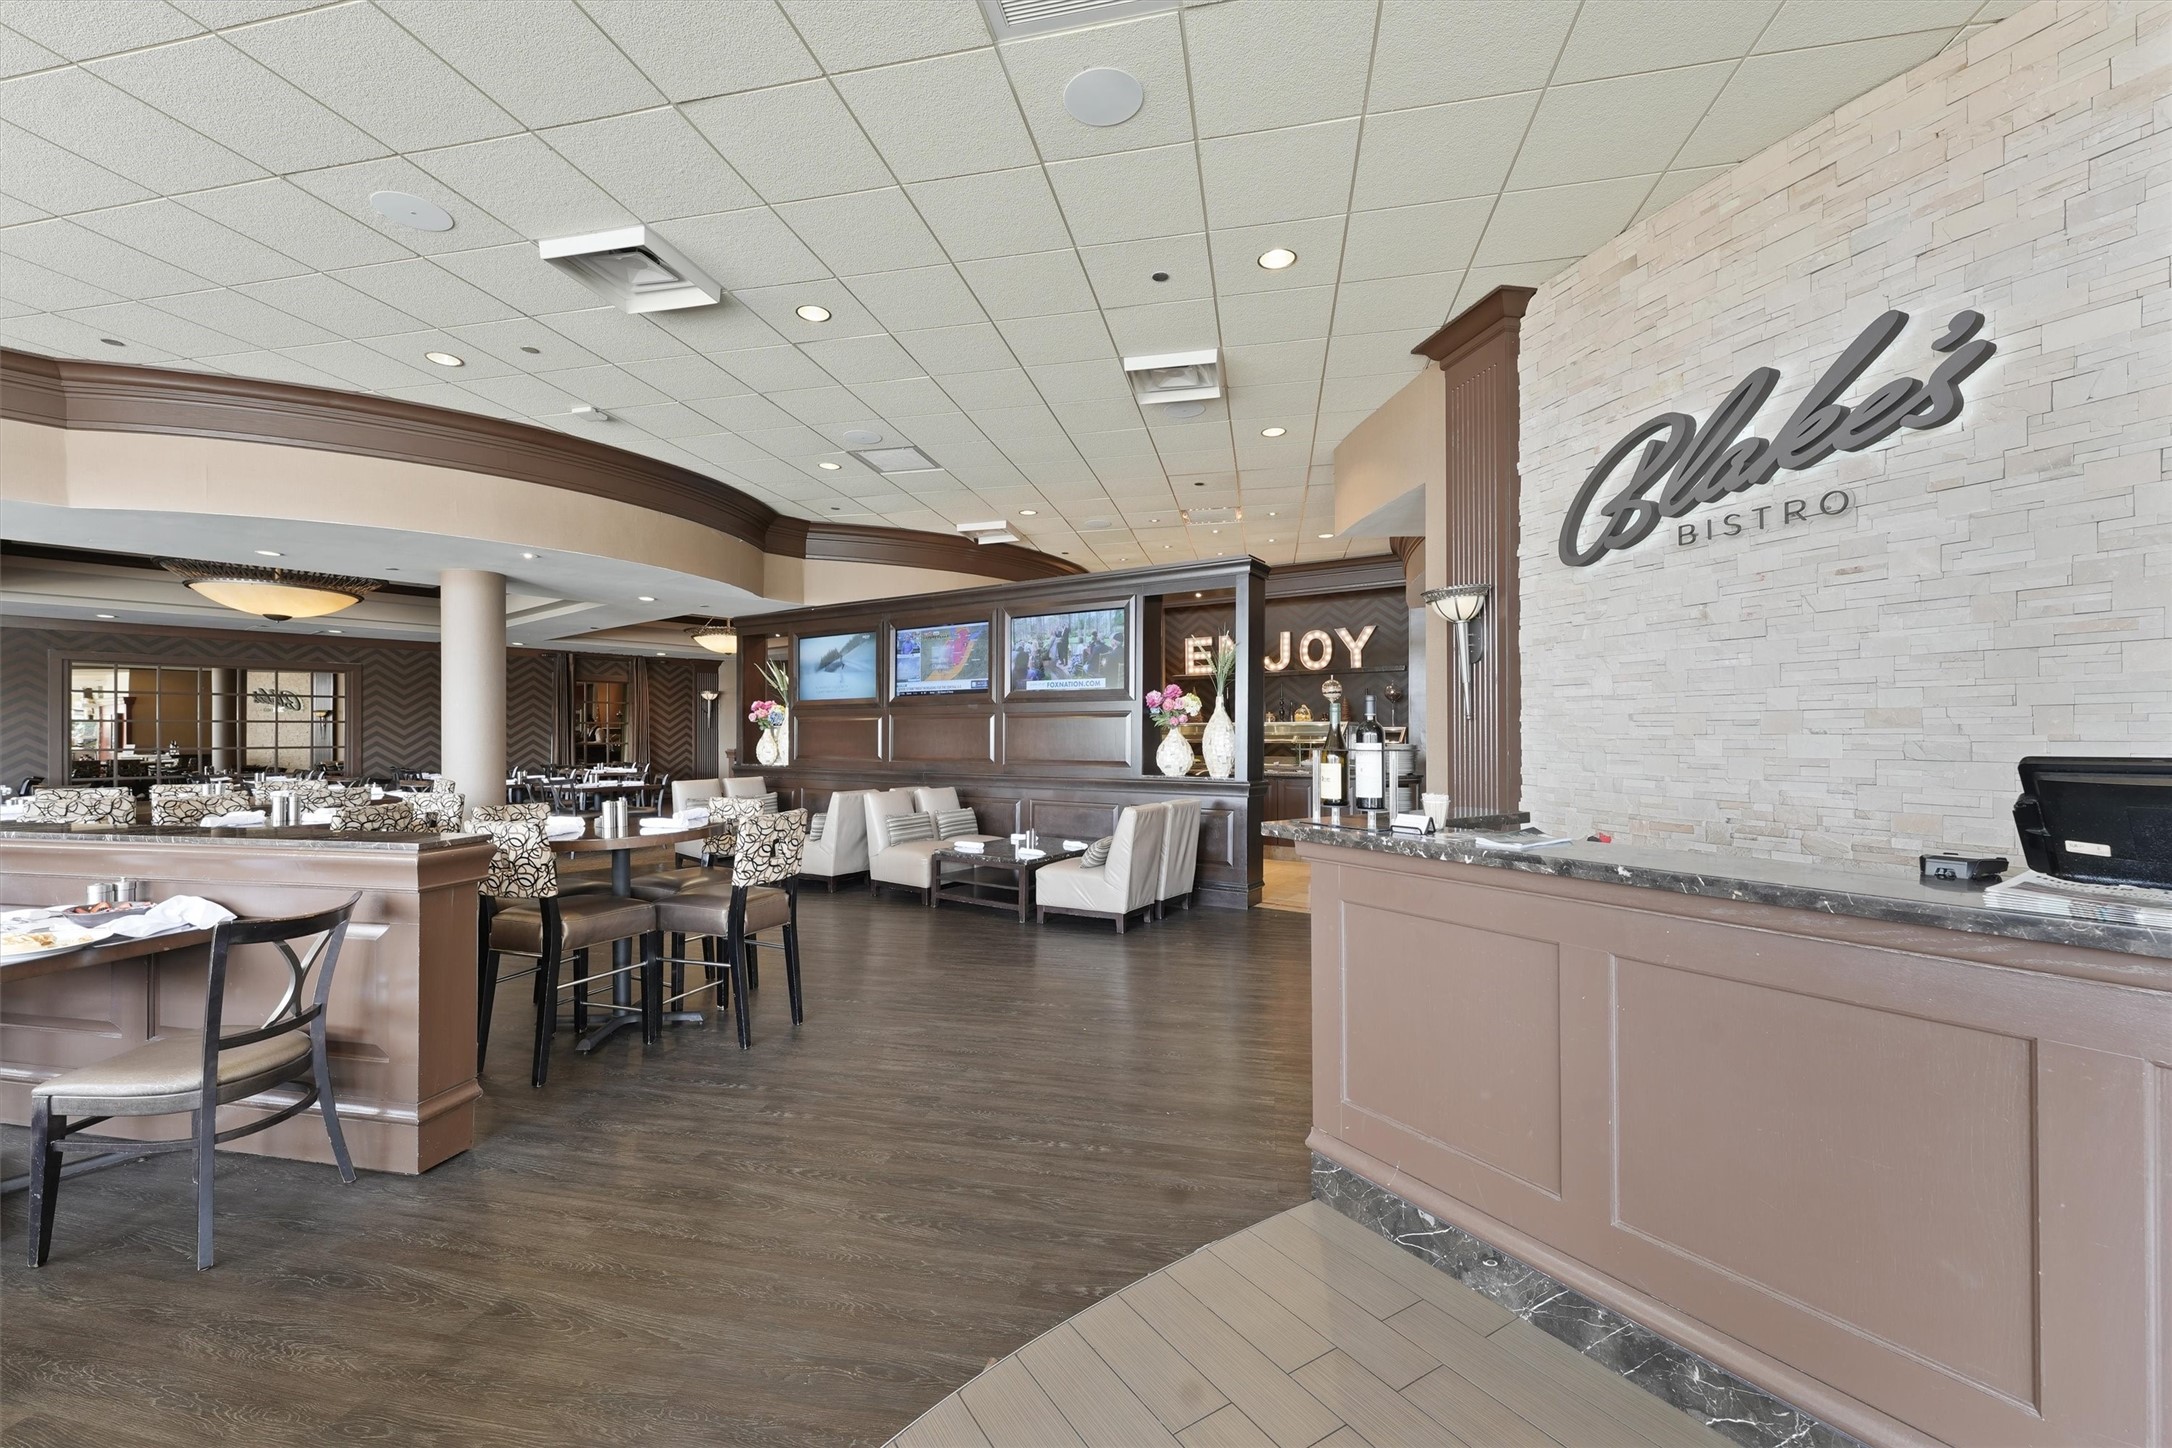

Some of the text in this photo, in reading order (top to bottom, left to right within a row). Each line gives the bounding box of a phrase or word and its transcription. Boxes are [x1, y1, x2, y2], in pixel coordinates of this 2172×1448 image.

[1558, 309, 1997, 567] Blake's
[1677, 490, 1852, 547] BISTRO
[1046, 680, 1101, 688] FOXNATION.COM
